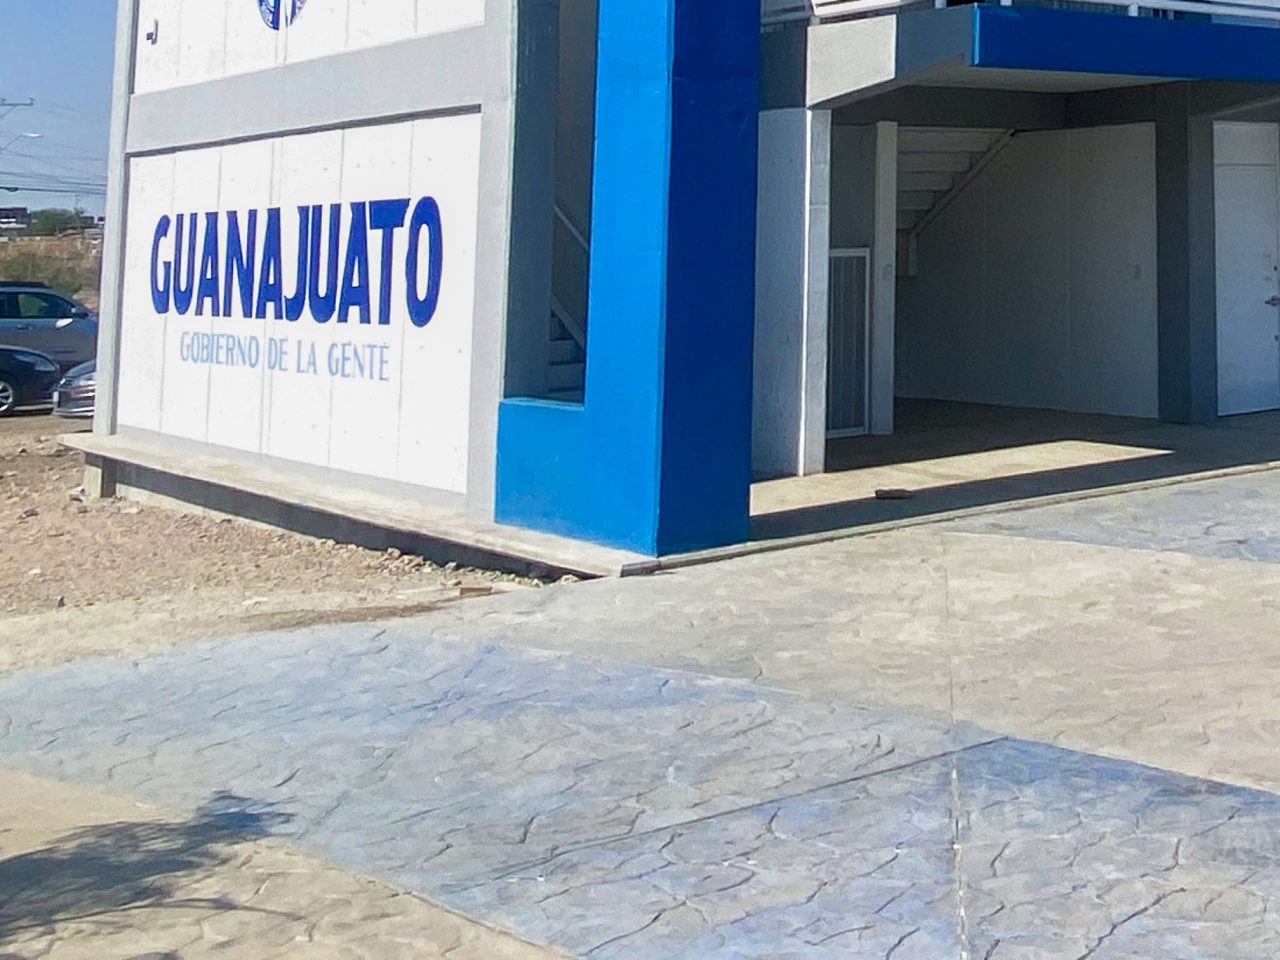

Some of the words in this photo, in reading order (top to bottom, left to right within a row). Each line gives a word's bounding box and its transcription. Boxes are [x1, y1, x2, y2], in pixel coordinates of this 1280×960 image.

[150, 196, 443, 328] GUANAJUATO
[180, 331, 259, 369] GOBIERNO
[267, 336, 288, 372] DE
[296, 340, 317, 375] LA
[327, 341, 390, 382] GENTE
